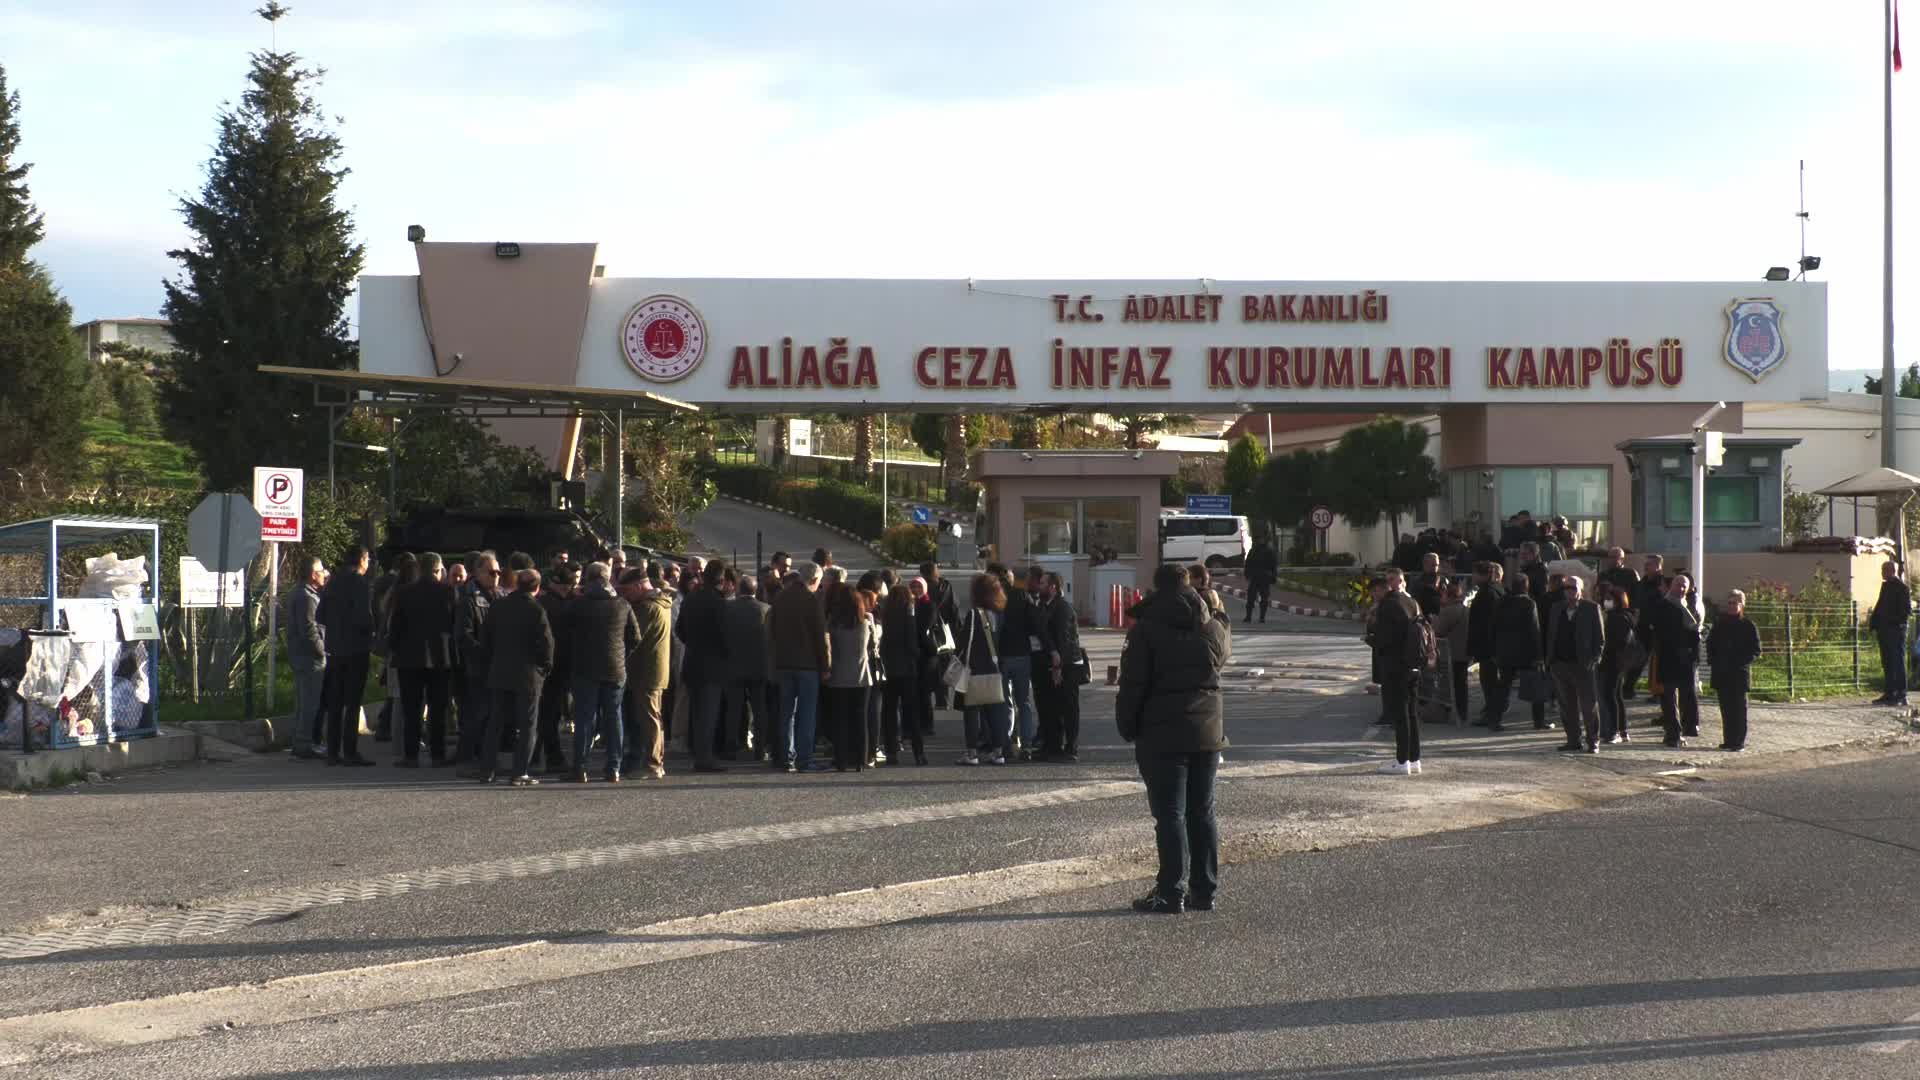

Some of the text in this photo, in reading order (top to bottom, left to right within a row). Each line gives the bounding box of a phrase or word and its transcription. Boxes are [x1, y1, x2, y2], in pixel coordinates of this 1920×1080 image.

[1052, 290, 1389, 322] T.C. ADALET BAKANLIĞI
[729, 337, 1685, 389] ALİAĞA CEZA İNFAZ KURUMLARI KAMPÜSÜ
[1314, 512, 1329, 524] 30
